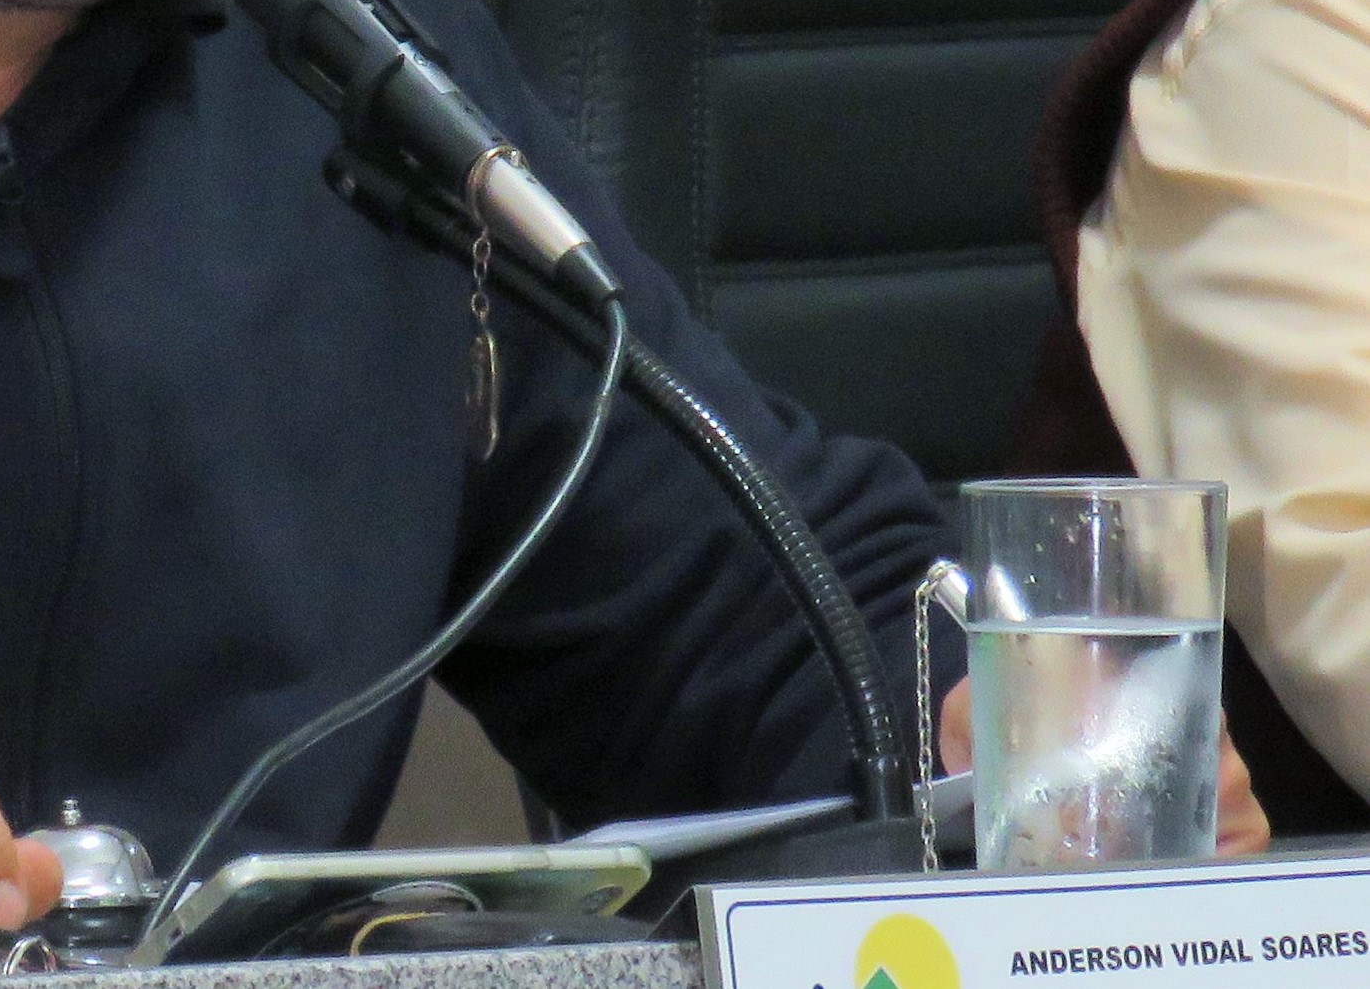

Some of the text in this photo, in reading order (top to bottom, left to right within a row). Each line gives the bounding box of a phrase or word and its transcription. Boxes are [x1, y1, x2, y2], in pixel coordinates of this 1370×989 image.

[1010, 930, 1369, 976] ANDERSON VIDAL SOARES
